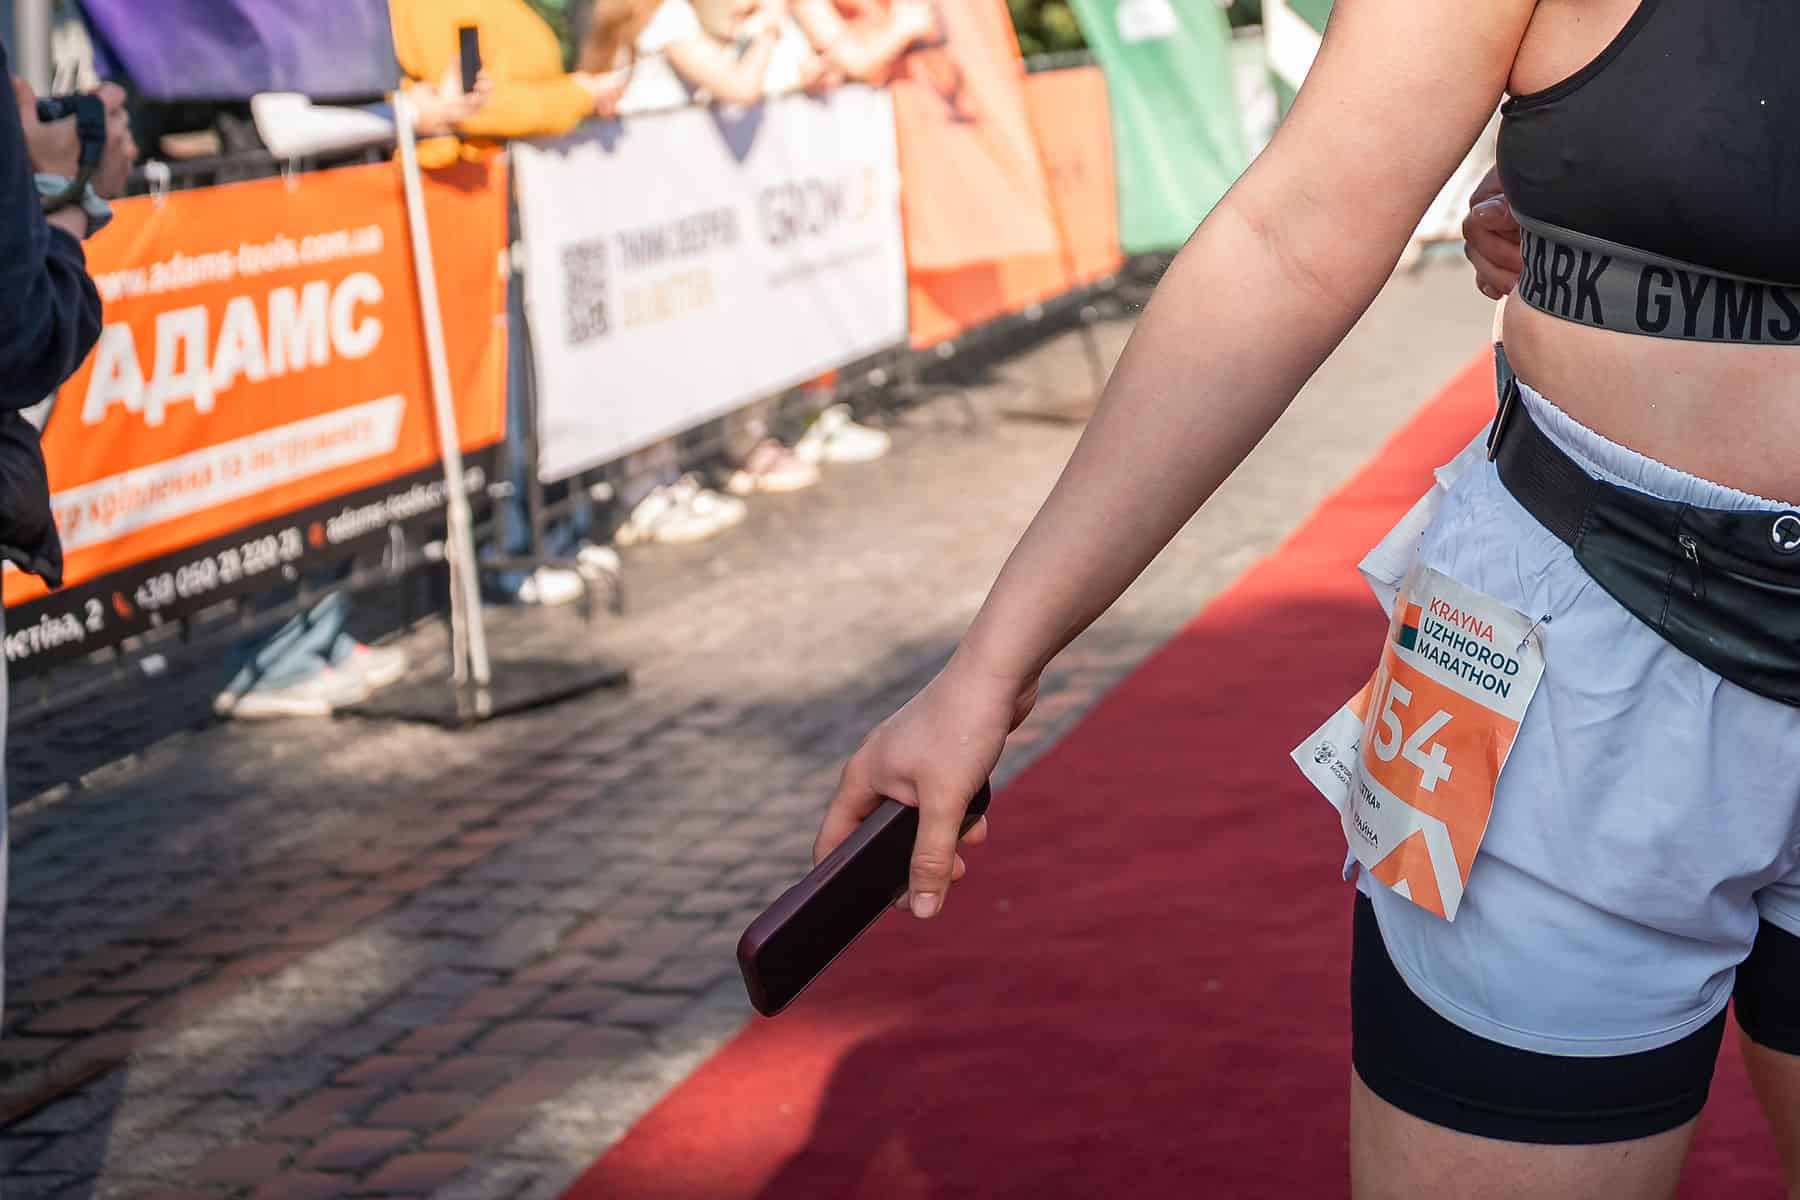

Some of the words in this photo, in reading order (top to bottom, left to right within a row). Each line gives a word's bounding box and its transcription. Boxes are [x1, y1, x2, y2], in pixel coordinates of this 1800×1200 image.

[82, 272, 385, 425] АДАМС
[1422, 616, 1520, 677] UZHHOROD
[1429, 597, 1494, 642] KRAYNA
[1417, 640, 1511, 698] MARATHON
